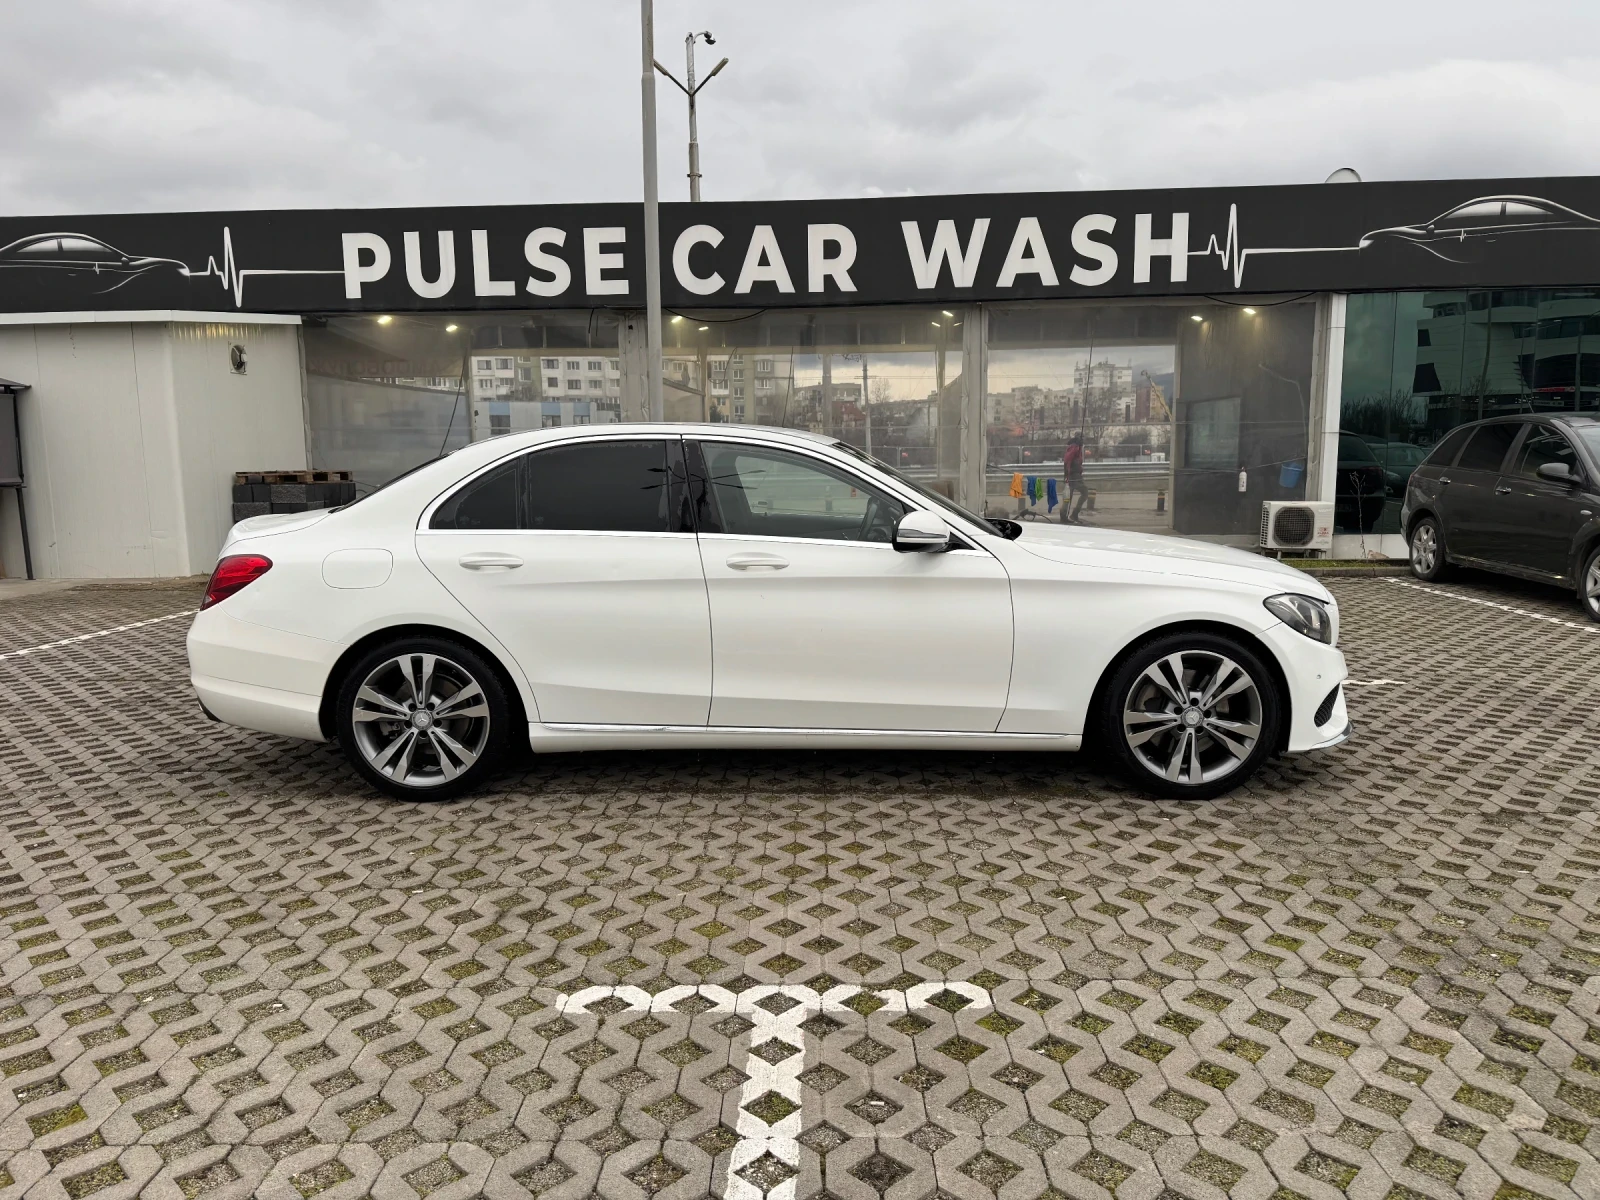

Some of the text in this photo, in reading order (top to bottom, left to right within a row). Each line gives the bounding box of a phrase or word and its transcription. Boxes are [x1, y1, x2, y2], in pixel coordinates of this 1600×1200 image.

[342, 212, 1189, 300] PULSE CAR WASH
